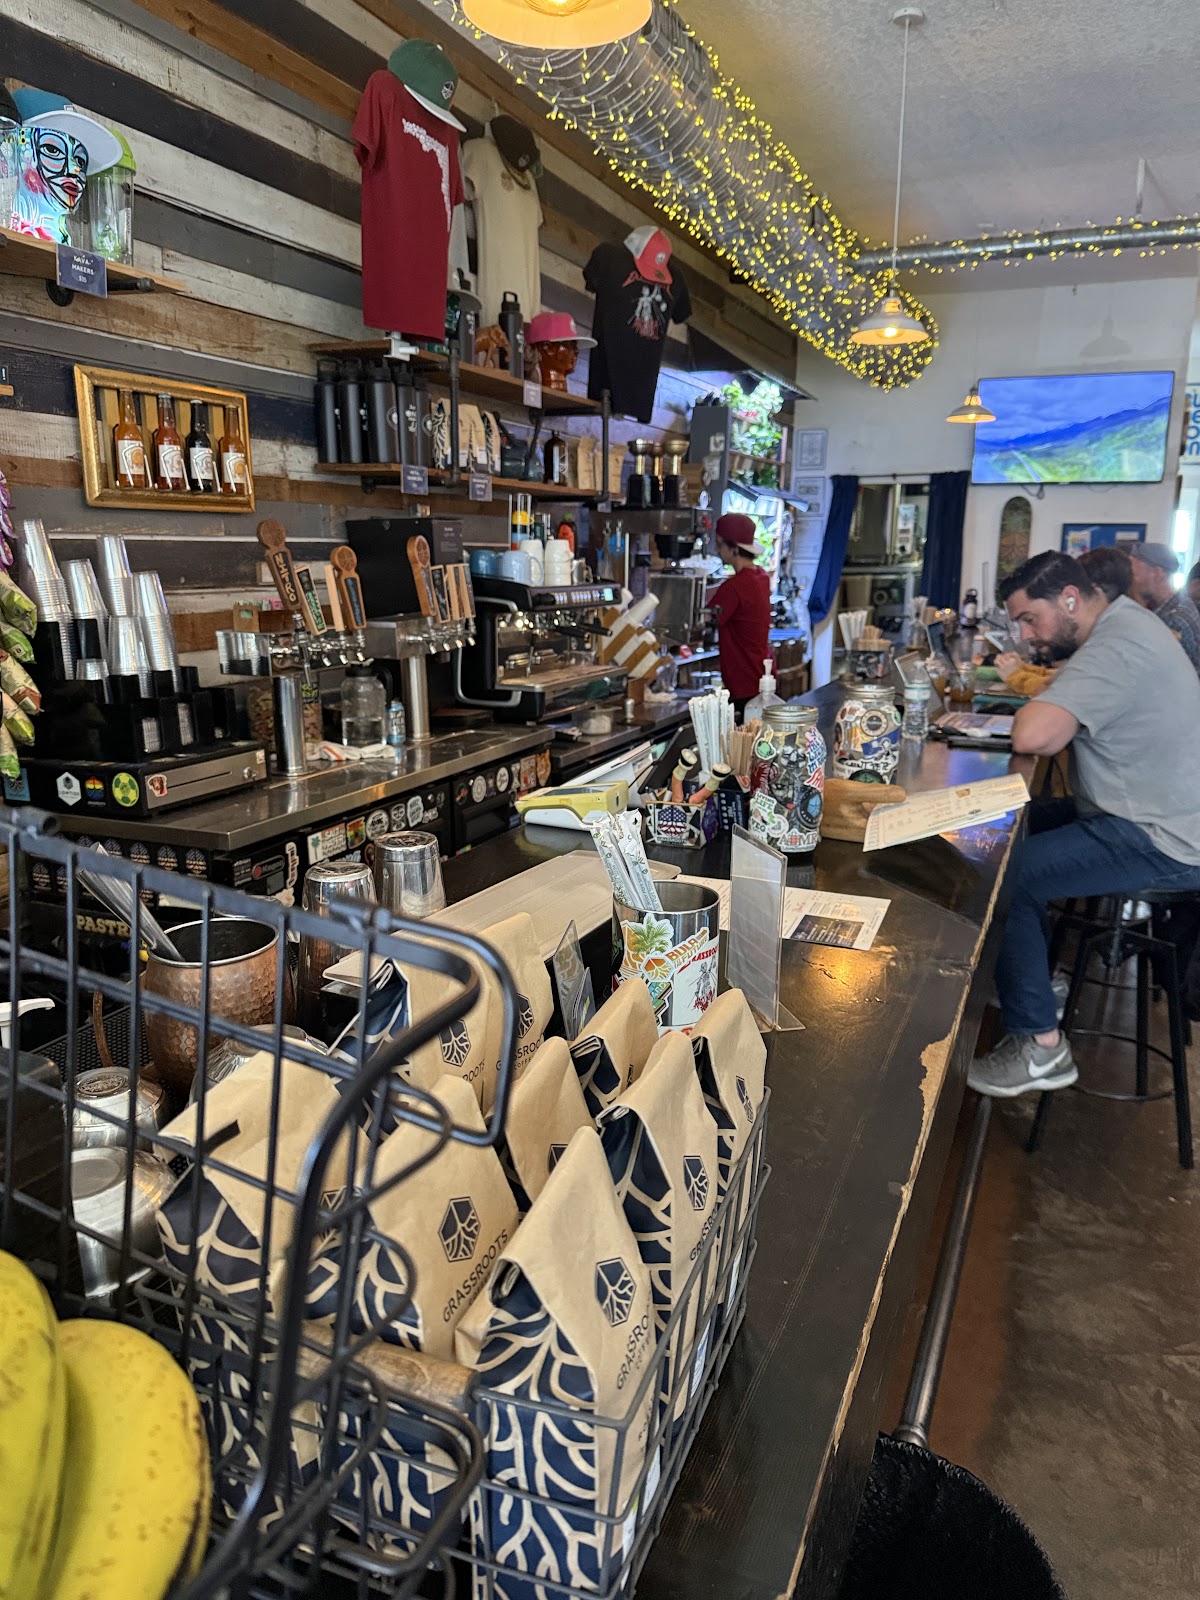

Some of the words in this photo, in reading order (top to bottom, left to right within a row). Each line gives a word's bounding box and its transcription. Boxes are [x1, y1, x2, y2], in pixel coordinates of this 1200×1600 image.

[71, 263, 94, 275] MAKERS
[274, 552, 297, 602] NITRO
[754, 797, 774, 811] LIFE
[751, 817, 767, 833] VEG
[75, 914, 131, 938] PASTR
[664, 937, 699, 962] BULA
[680, 935, 708, 964] FUTURE
[513, 1058, 532, 1071] COFFE
[443, 1229, 508, 1322] GRASSROOTS
[616, 1313, 650, 1391] GRASSRO
